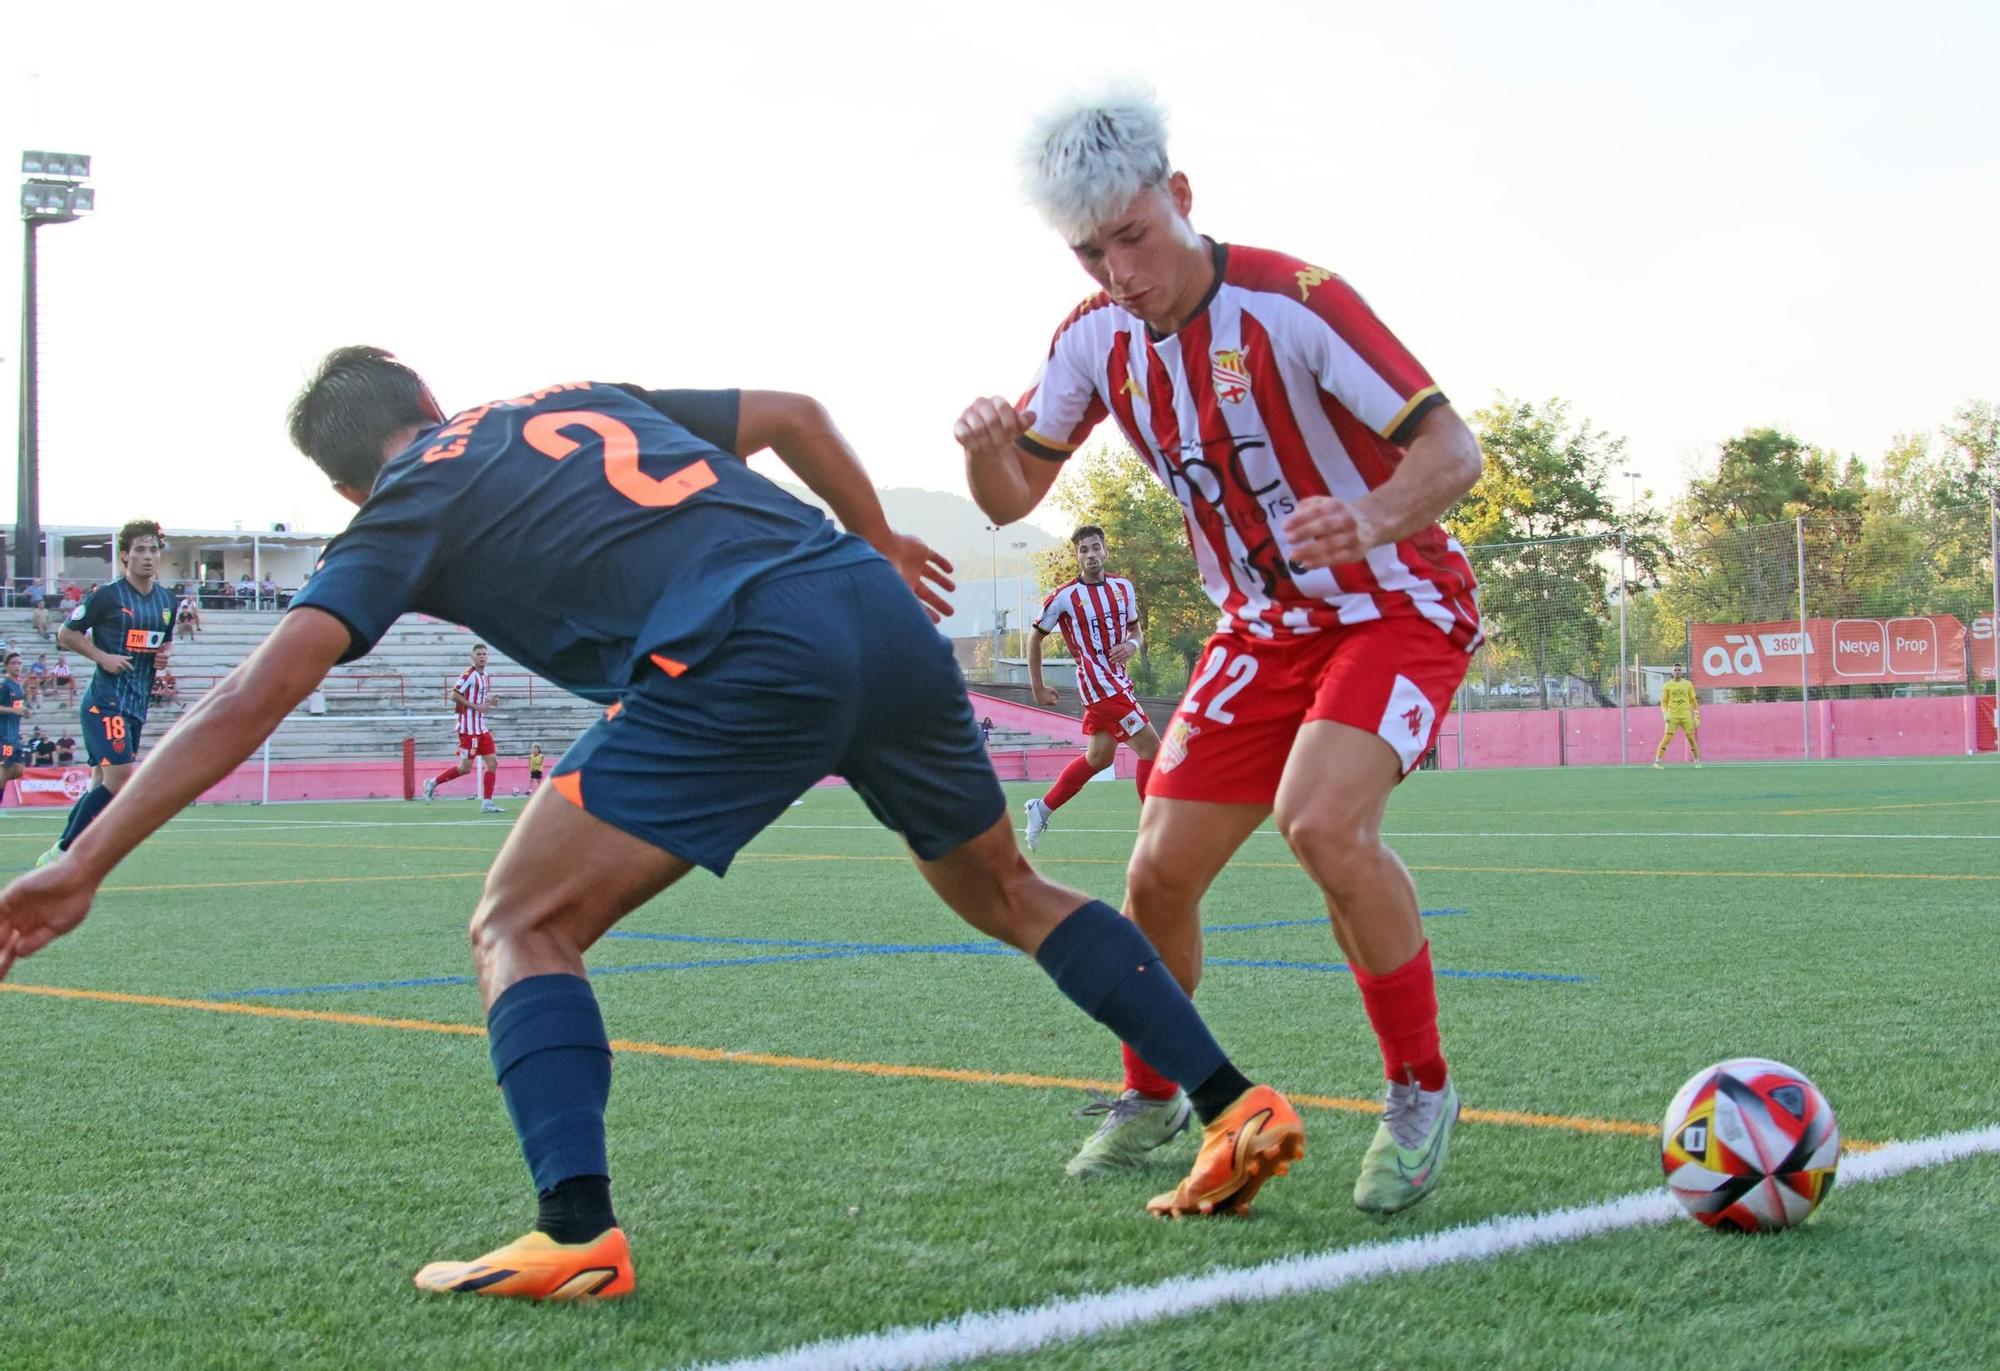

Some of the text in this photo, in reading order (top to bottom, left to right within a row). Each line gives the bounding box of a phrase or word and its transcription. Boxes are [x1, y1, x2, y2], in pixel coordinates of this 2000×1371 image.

[523, 410, 719, 507] 2
[131, 634, 145, 644] TM
[1839, 639, 1880, 657] Netya
[1896, 636, 1928, 656] Prop
[1180, 645, 1260, 726] 22
[102, 716, 126, 740] 18
[2, 744, 14, 757] 19
